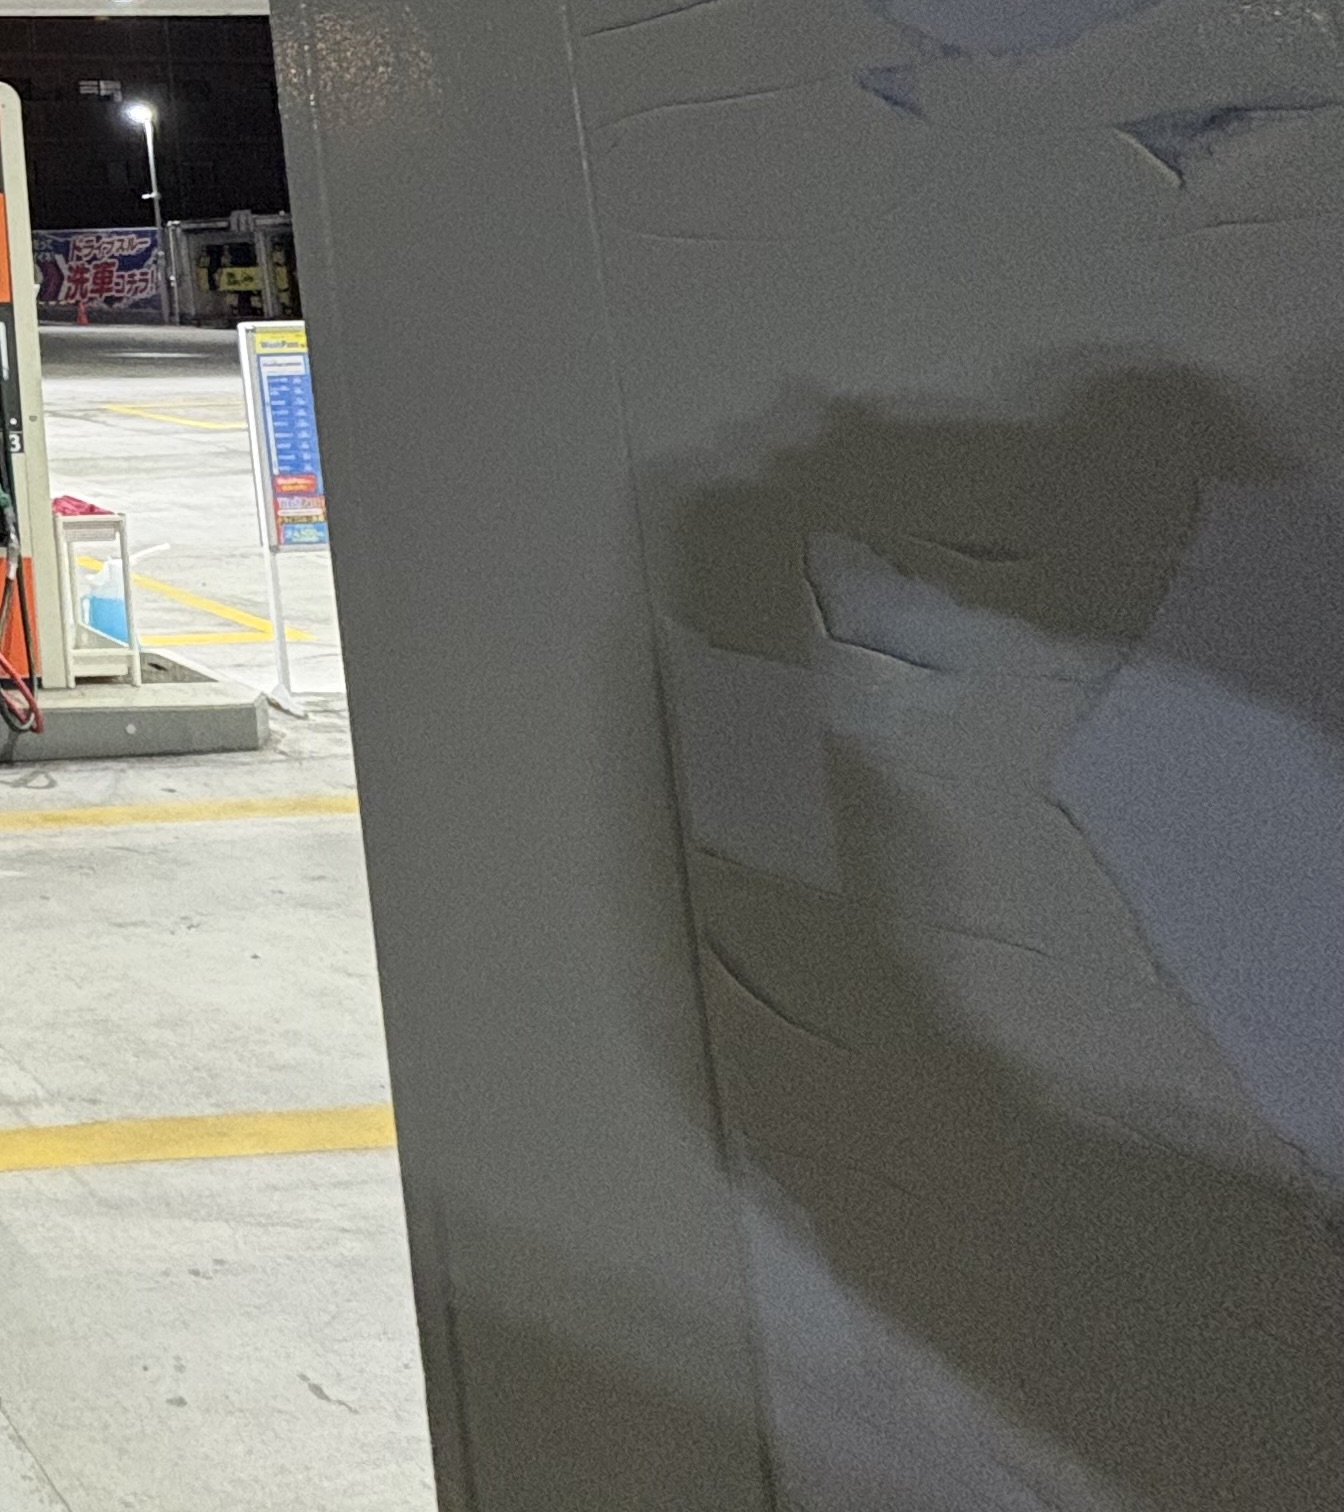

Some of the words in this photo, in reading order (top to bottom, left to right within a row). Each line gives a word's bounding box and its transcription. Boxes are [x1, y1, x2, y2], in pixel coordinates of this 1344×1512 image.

[68, 234, 151, 262] ドライブスルー
[8, 433, 22, 454] 3
